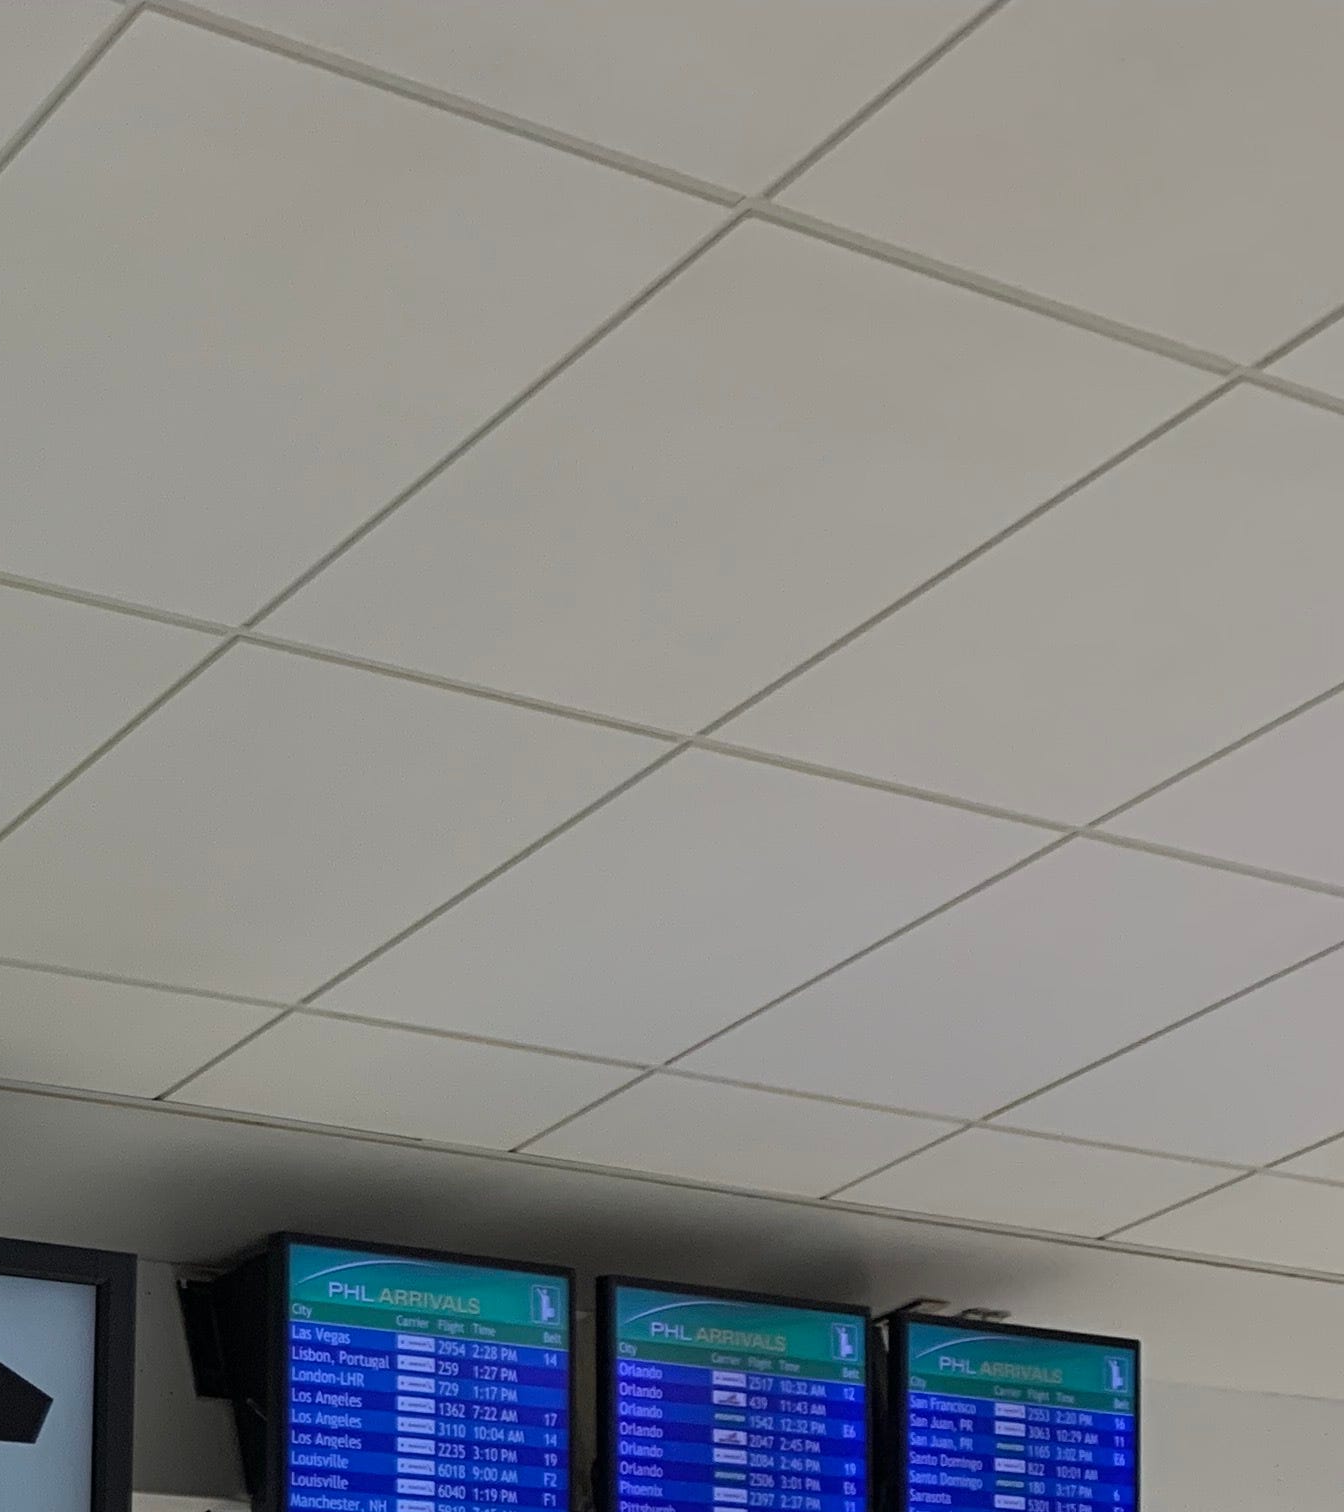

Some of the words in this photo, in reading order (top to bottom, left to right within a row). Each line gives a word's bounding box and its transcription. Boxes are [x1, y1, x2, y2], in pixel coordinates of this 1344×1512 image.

[329, 1281, 375, 1302] PHL
[379, 1288, 480, 1314] ARRIVALS
[651, 1321, 692, 1341] PHL
[292, 1325, 312, 1340] Las
[315, 1327, 351, 1346] Vegas
[438, 1340, 466, 1356] 2954
[472, 1344, 498, 1360] 2:28
[501, 1347, 517, 1362] PM
[544, 1353, 557, 1366] 14
[939, 1356, 976, 1374] PHL
